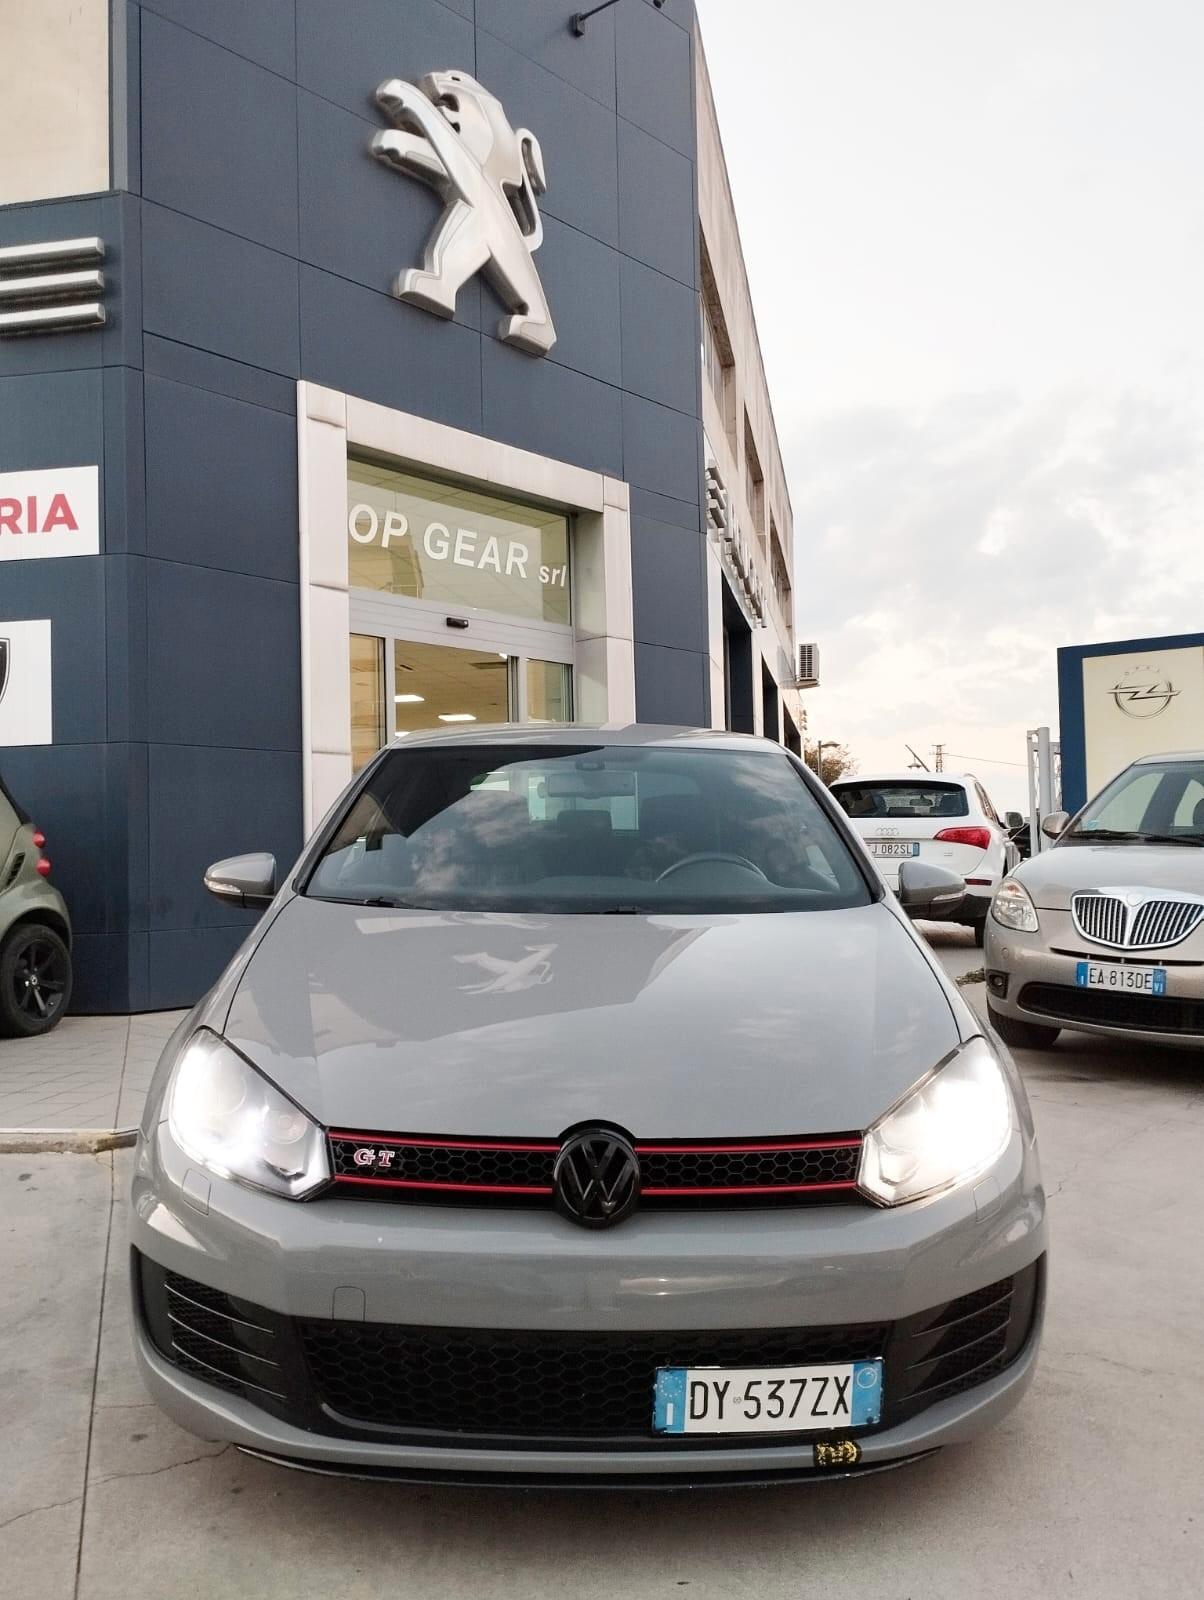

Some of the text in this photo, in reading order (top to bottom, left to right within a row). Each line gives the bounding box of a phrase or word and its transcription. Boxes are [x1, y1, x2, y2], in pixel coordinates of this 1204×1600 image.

[0, 493, 79, 534] RIA
[423, 522, 529, 579] GEAR
[538, 565, 567, 587] srl
[881, 844, 912, 854] 082SL
[1089, 968, 1153, 990] EA 813DE
[353, 1148, 395, 1168] GT
[689, 1375, 852, 1420] DY 537ZX
